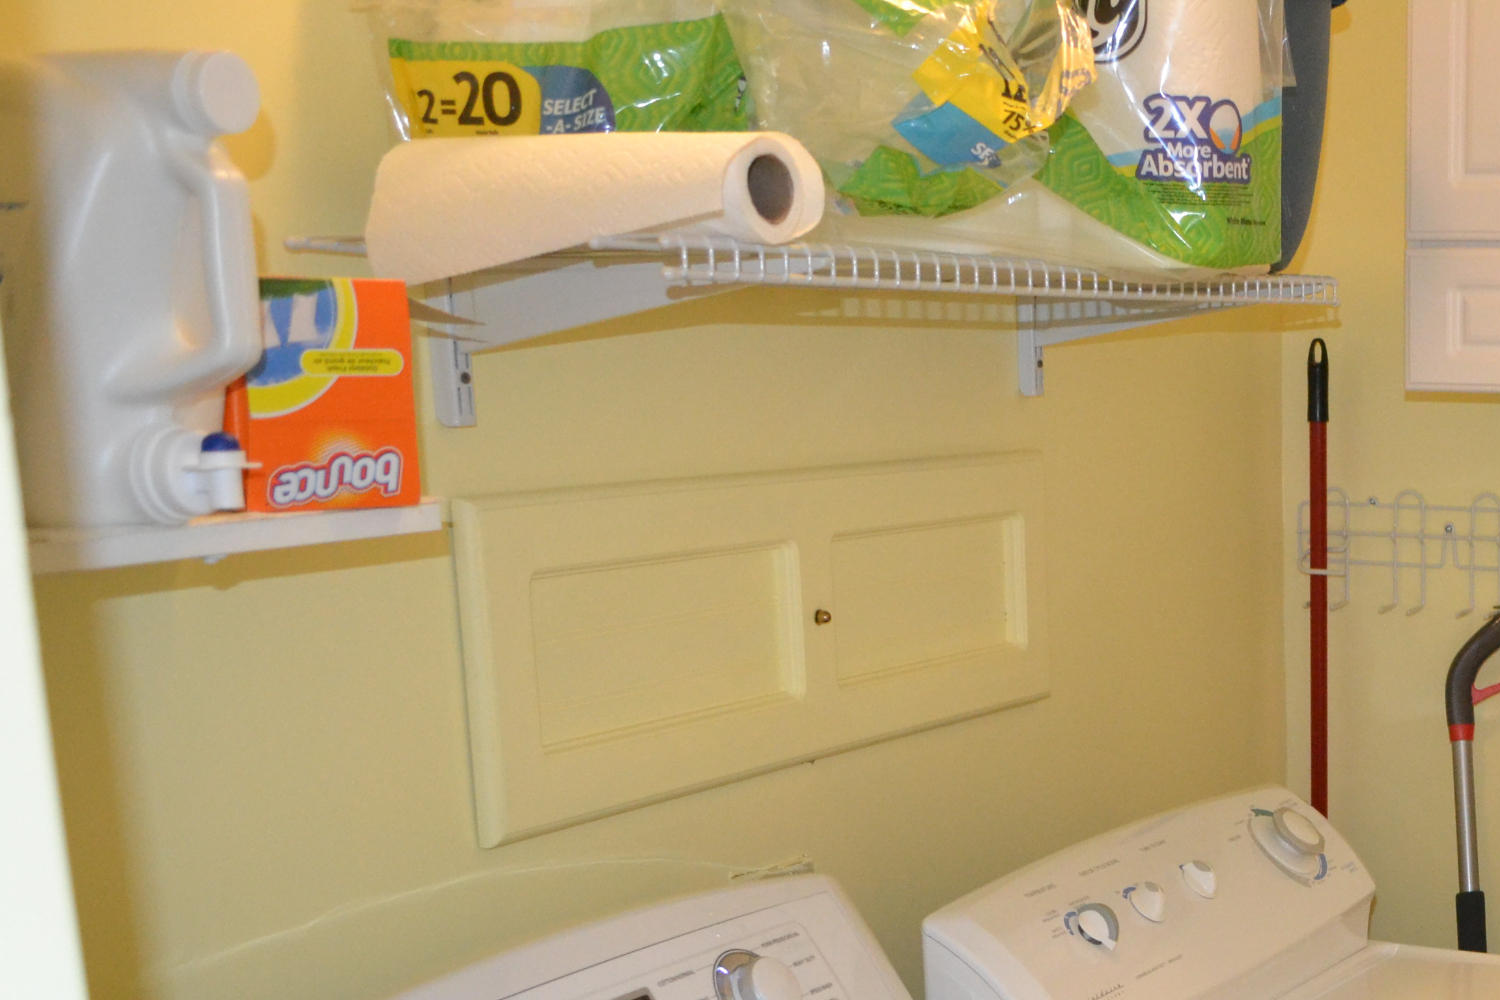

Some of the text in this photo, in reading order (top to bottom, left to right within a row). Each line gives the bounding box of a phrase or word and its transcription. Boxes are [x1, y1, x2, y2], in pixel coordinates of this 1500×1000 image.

[543, 89, 596, 115] SELECT
[1148, 101, 1207, 139] 2X
[1167, 142, 1212, 159] More
[269, 449, 402, 506] bounce
